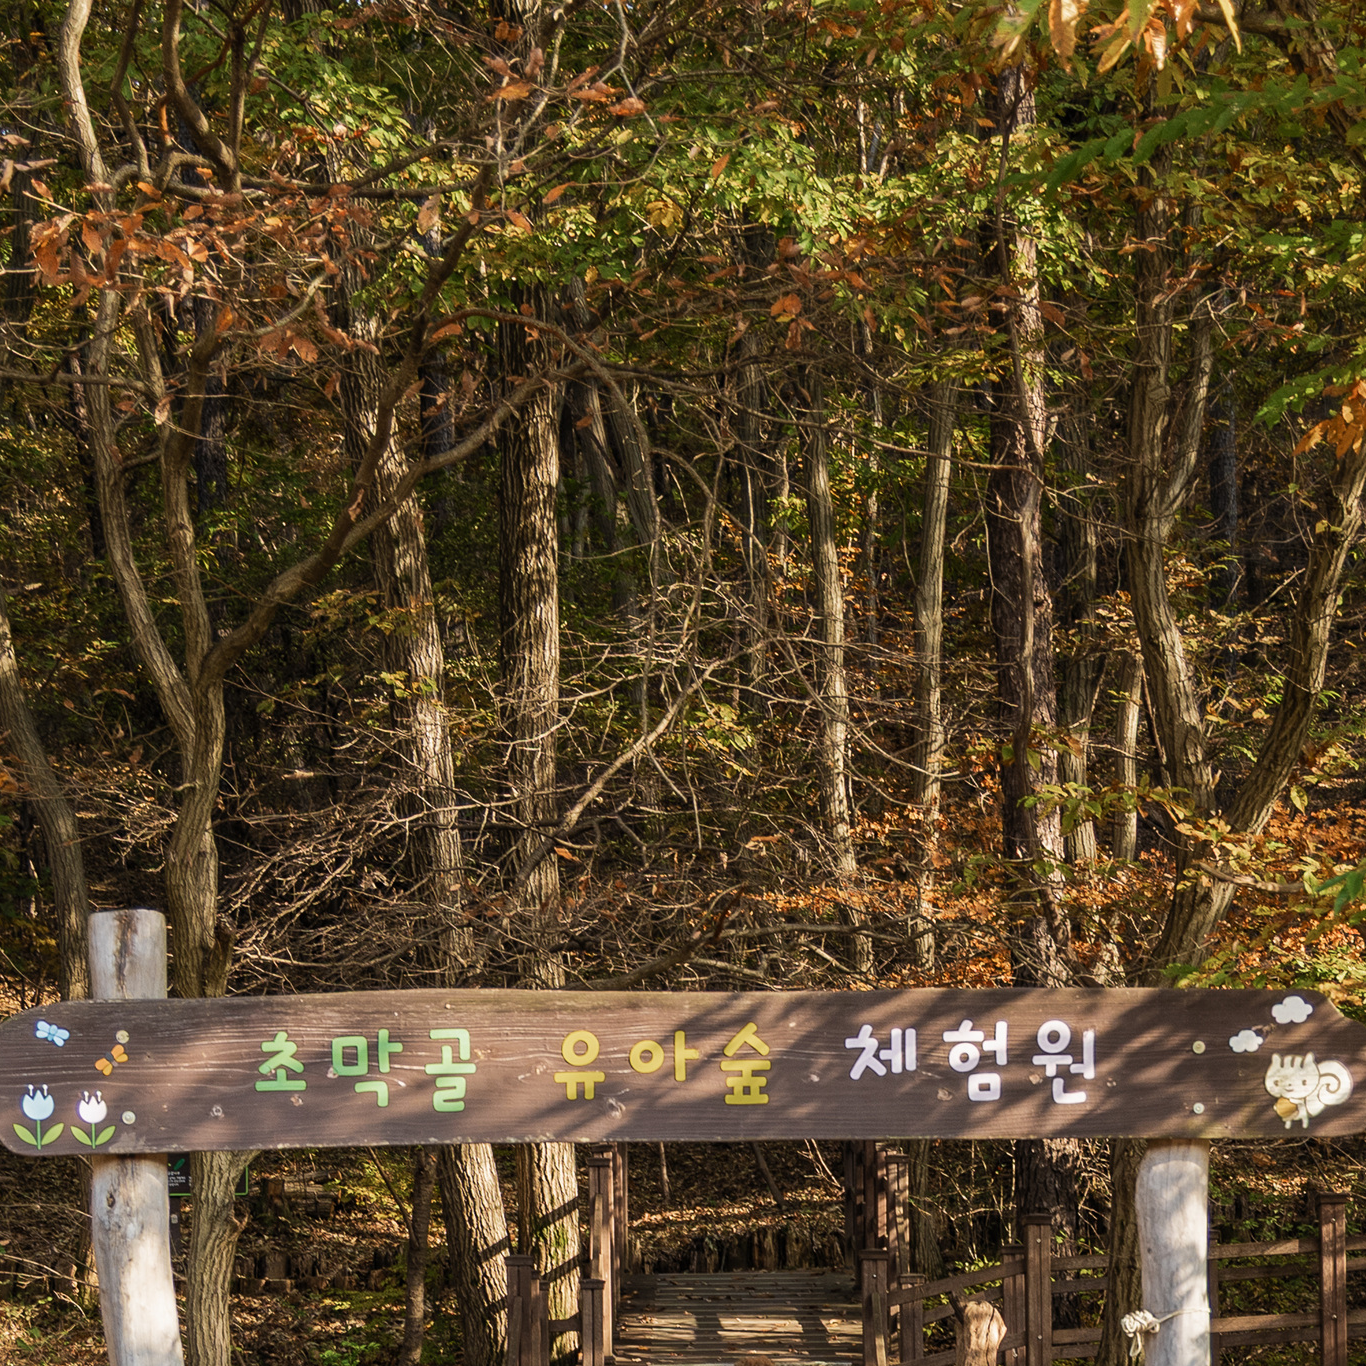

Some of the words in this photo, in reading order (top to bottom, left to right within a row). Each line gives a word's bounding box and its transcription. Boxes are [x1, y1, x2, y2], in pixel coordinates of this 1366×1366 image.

[254, 1028, 477, 1112] 초막골
[554, 1022, 771, 1105] 유아숲
[844, 1019, 1096, 1104] 체험원
